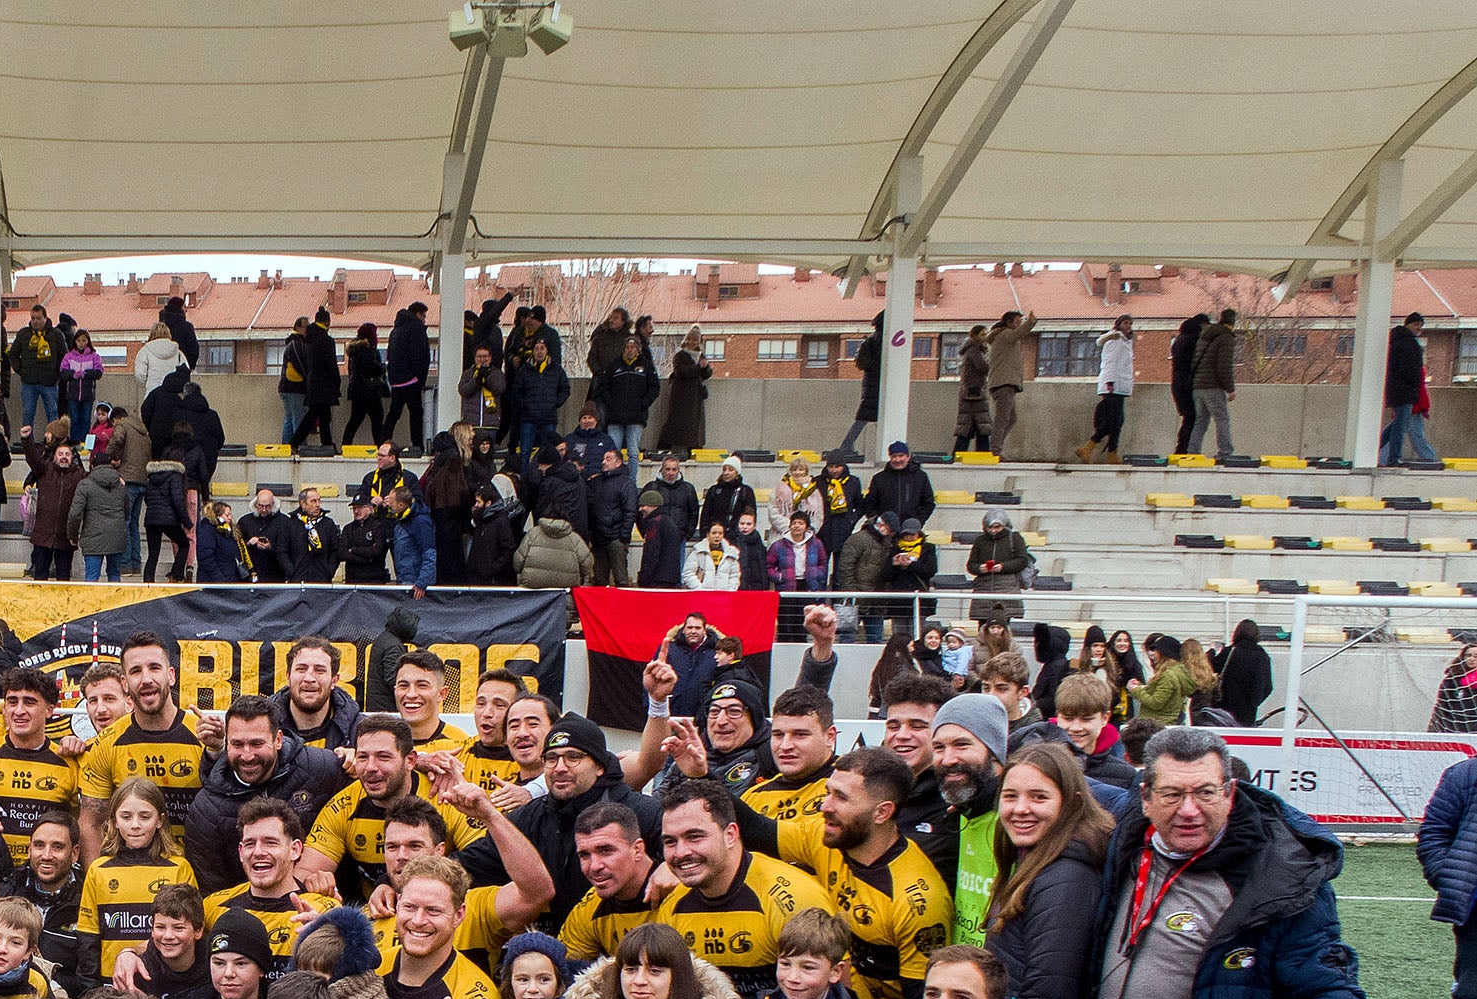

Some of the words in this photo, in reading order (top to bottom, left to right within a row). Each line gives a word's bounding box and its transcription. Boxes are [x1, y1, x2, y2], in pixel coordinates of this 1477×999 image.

[53, 644, 88, 658] RUGBY
[146, 764, 167, 777] nb
[11, 778, 32, 790] nb
[9, 809, 42, 821] Recol
[704, 939, 726, 955] nb
